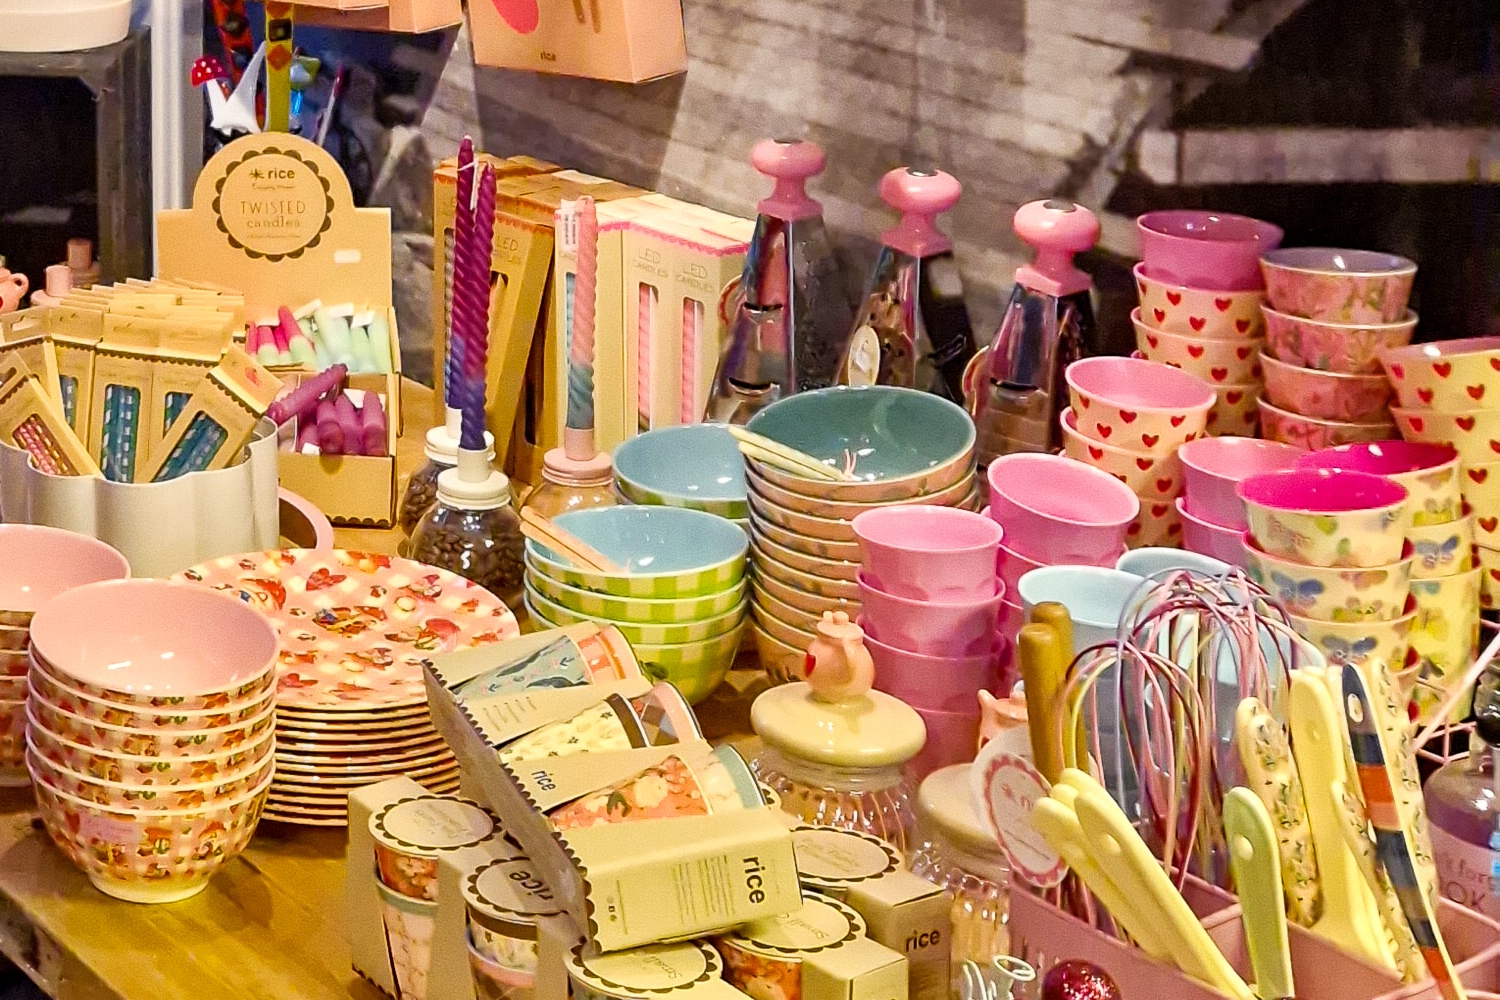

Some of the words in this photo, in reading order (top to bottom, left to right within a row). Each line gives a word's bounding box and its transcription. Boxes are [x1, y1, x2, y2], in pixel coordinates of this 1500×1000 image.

[267, 167, 296, 180] rice
[240, 200, 306, 214] TWISTED
[638, 247, 661, 264] LED
[683, 263, 708, 279] LED
[530, 769, 557, 793] rice
[508, 870, 554, 901] rice
[742, 855, 767, 905] rice
[905, 927, 940, 952] rice
